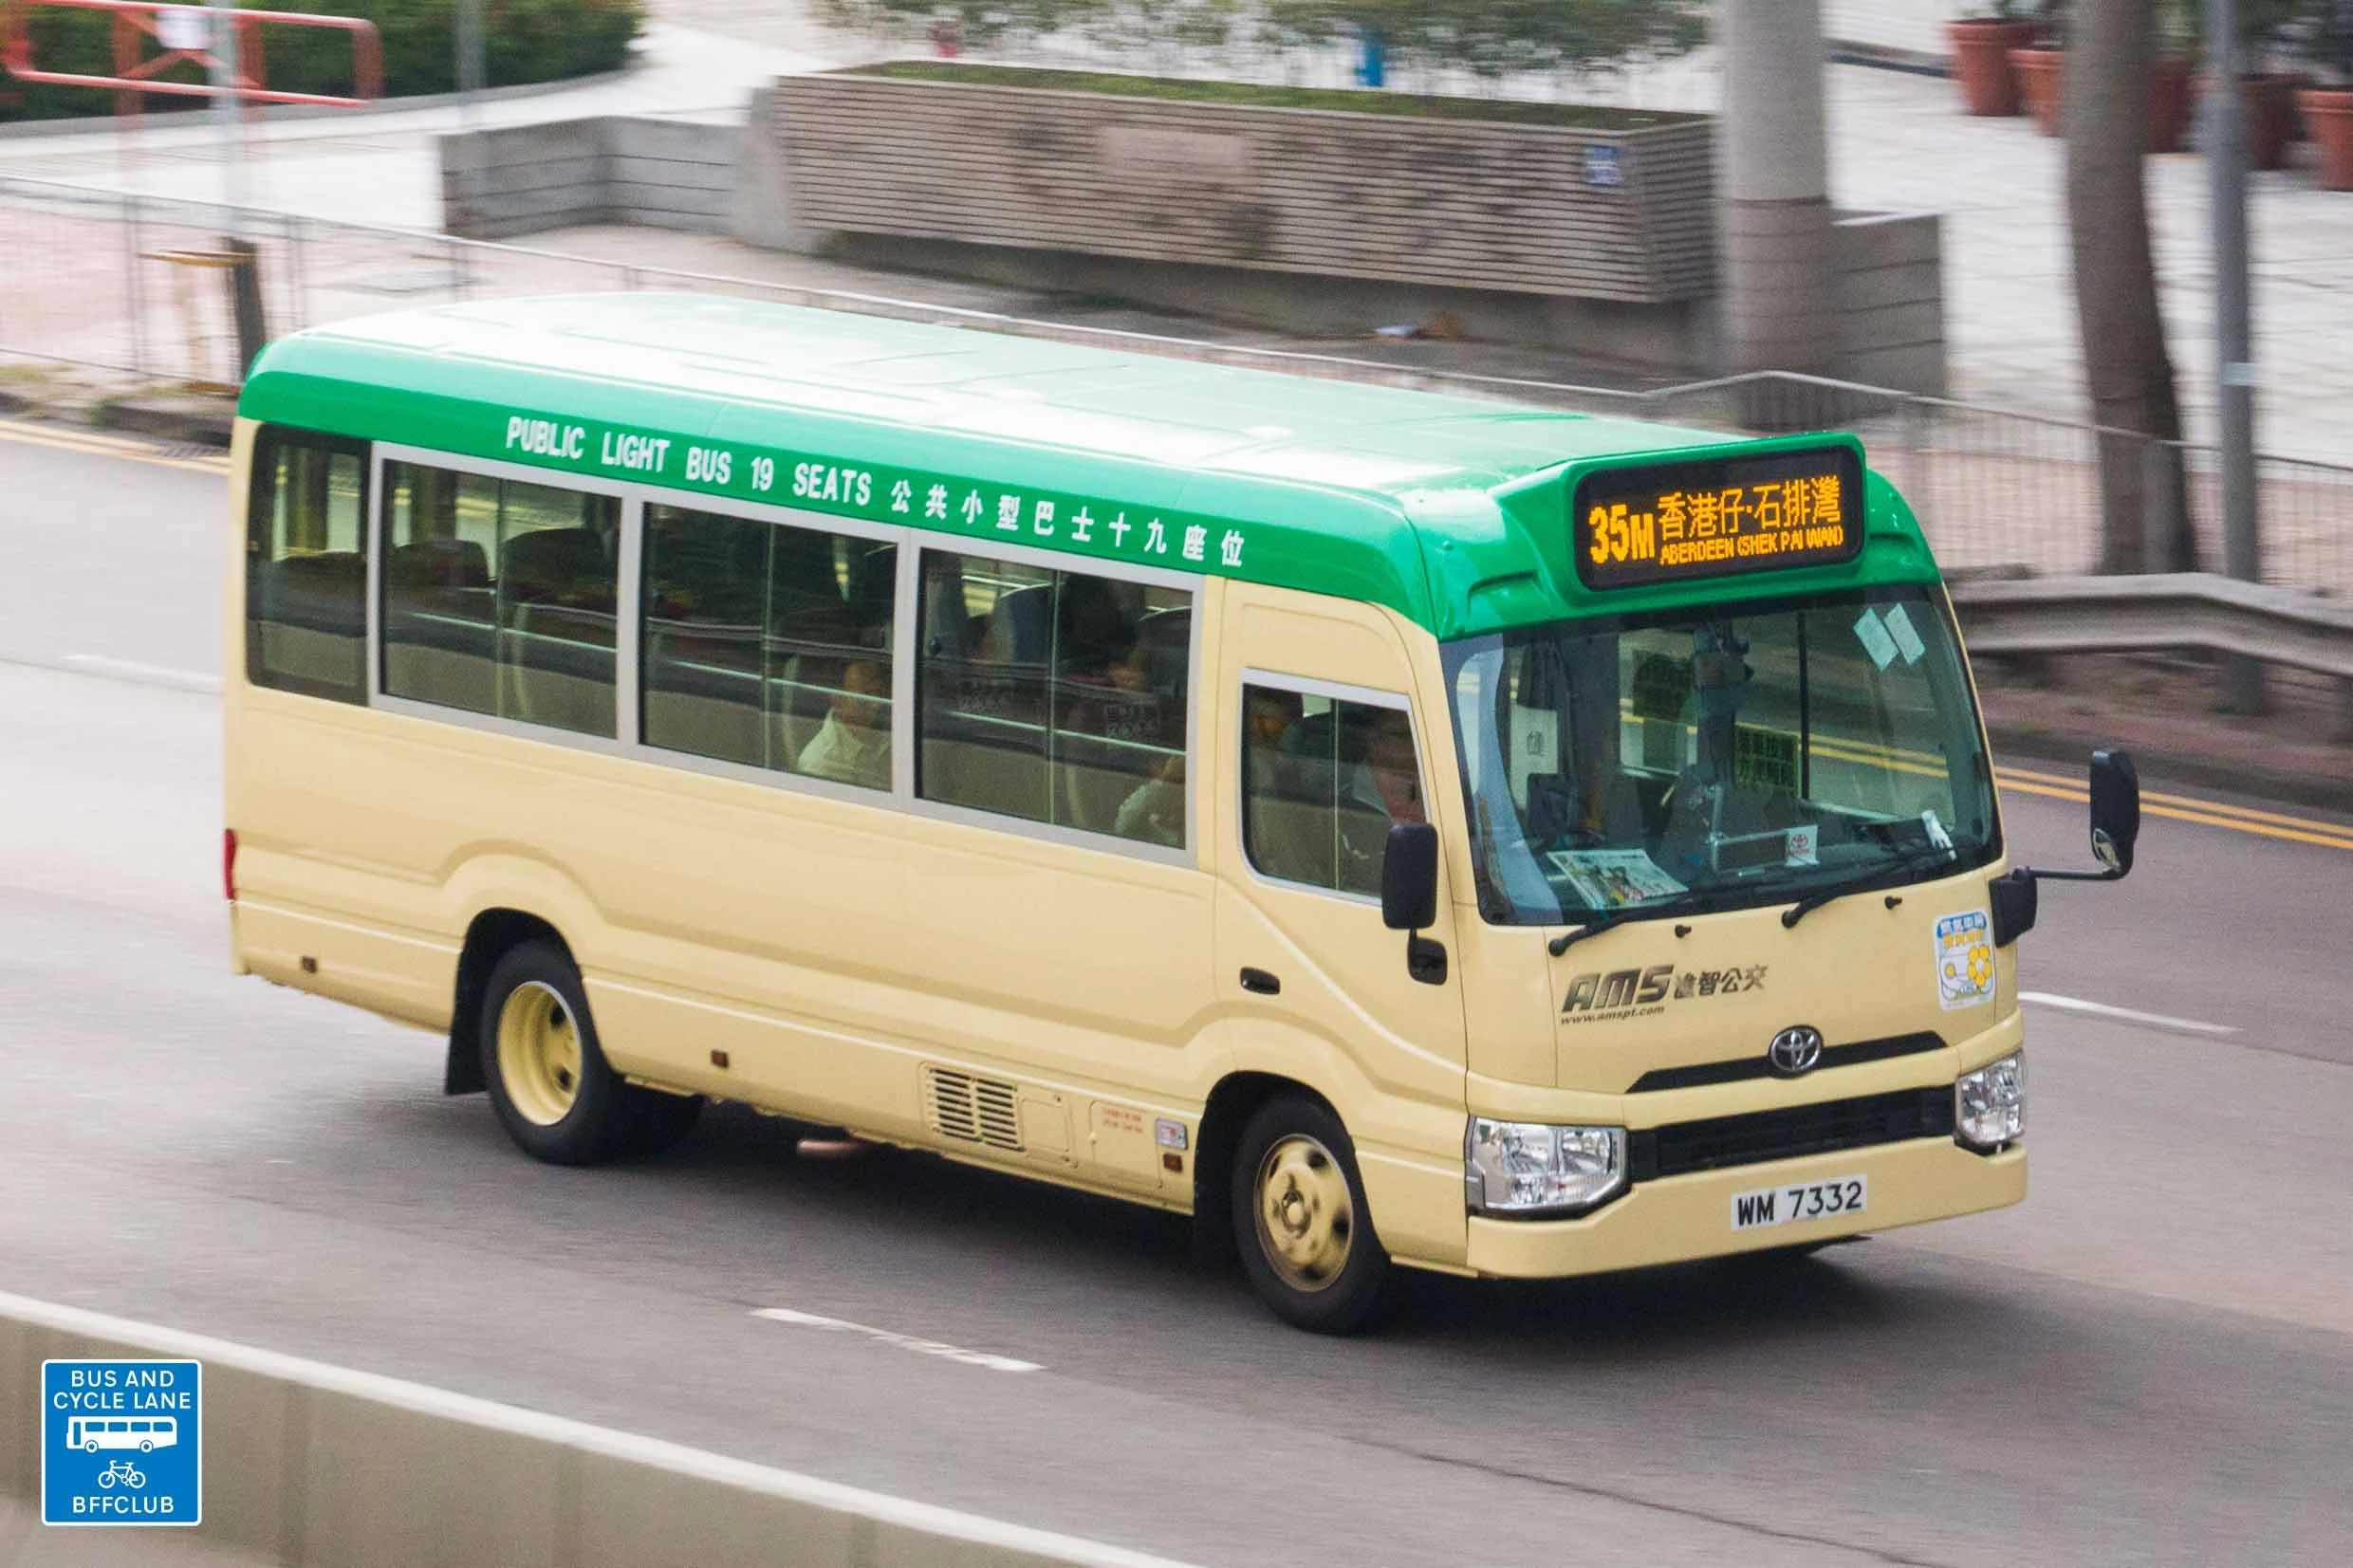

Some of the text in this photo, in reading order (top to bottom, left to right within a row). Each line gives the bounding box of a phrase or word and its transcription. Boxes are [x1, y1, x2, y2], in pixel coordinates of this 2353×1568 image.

[506, 416, 872, 507] PUBLIC LIGHT BUS 19 SEATS
[890, 479, 1245, 568] 公共小型巴士十九座位
[1588, 504, 1656, 564] 35M
[1659, 541, 1735, 566] ABERDEEN
[1737, 535, 1778, 557] (SHEK
[1781, 531, 1804, 552] PAI
[1562, 964, 1675, 1013] AMS
[1561, 1006, 1665, 1025] www.amspt.com
[1737, 1181, 1862, 1226] WM 7332
